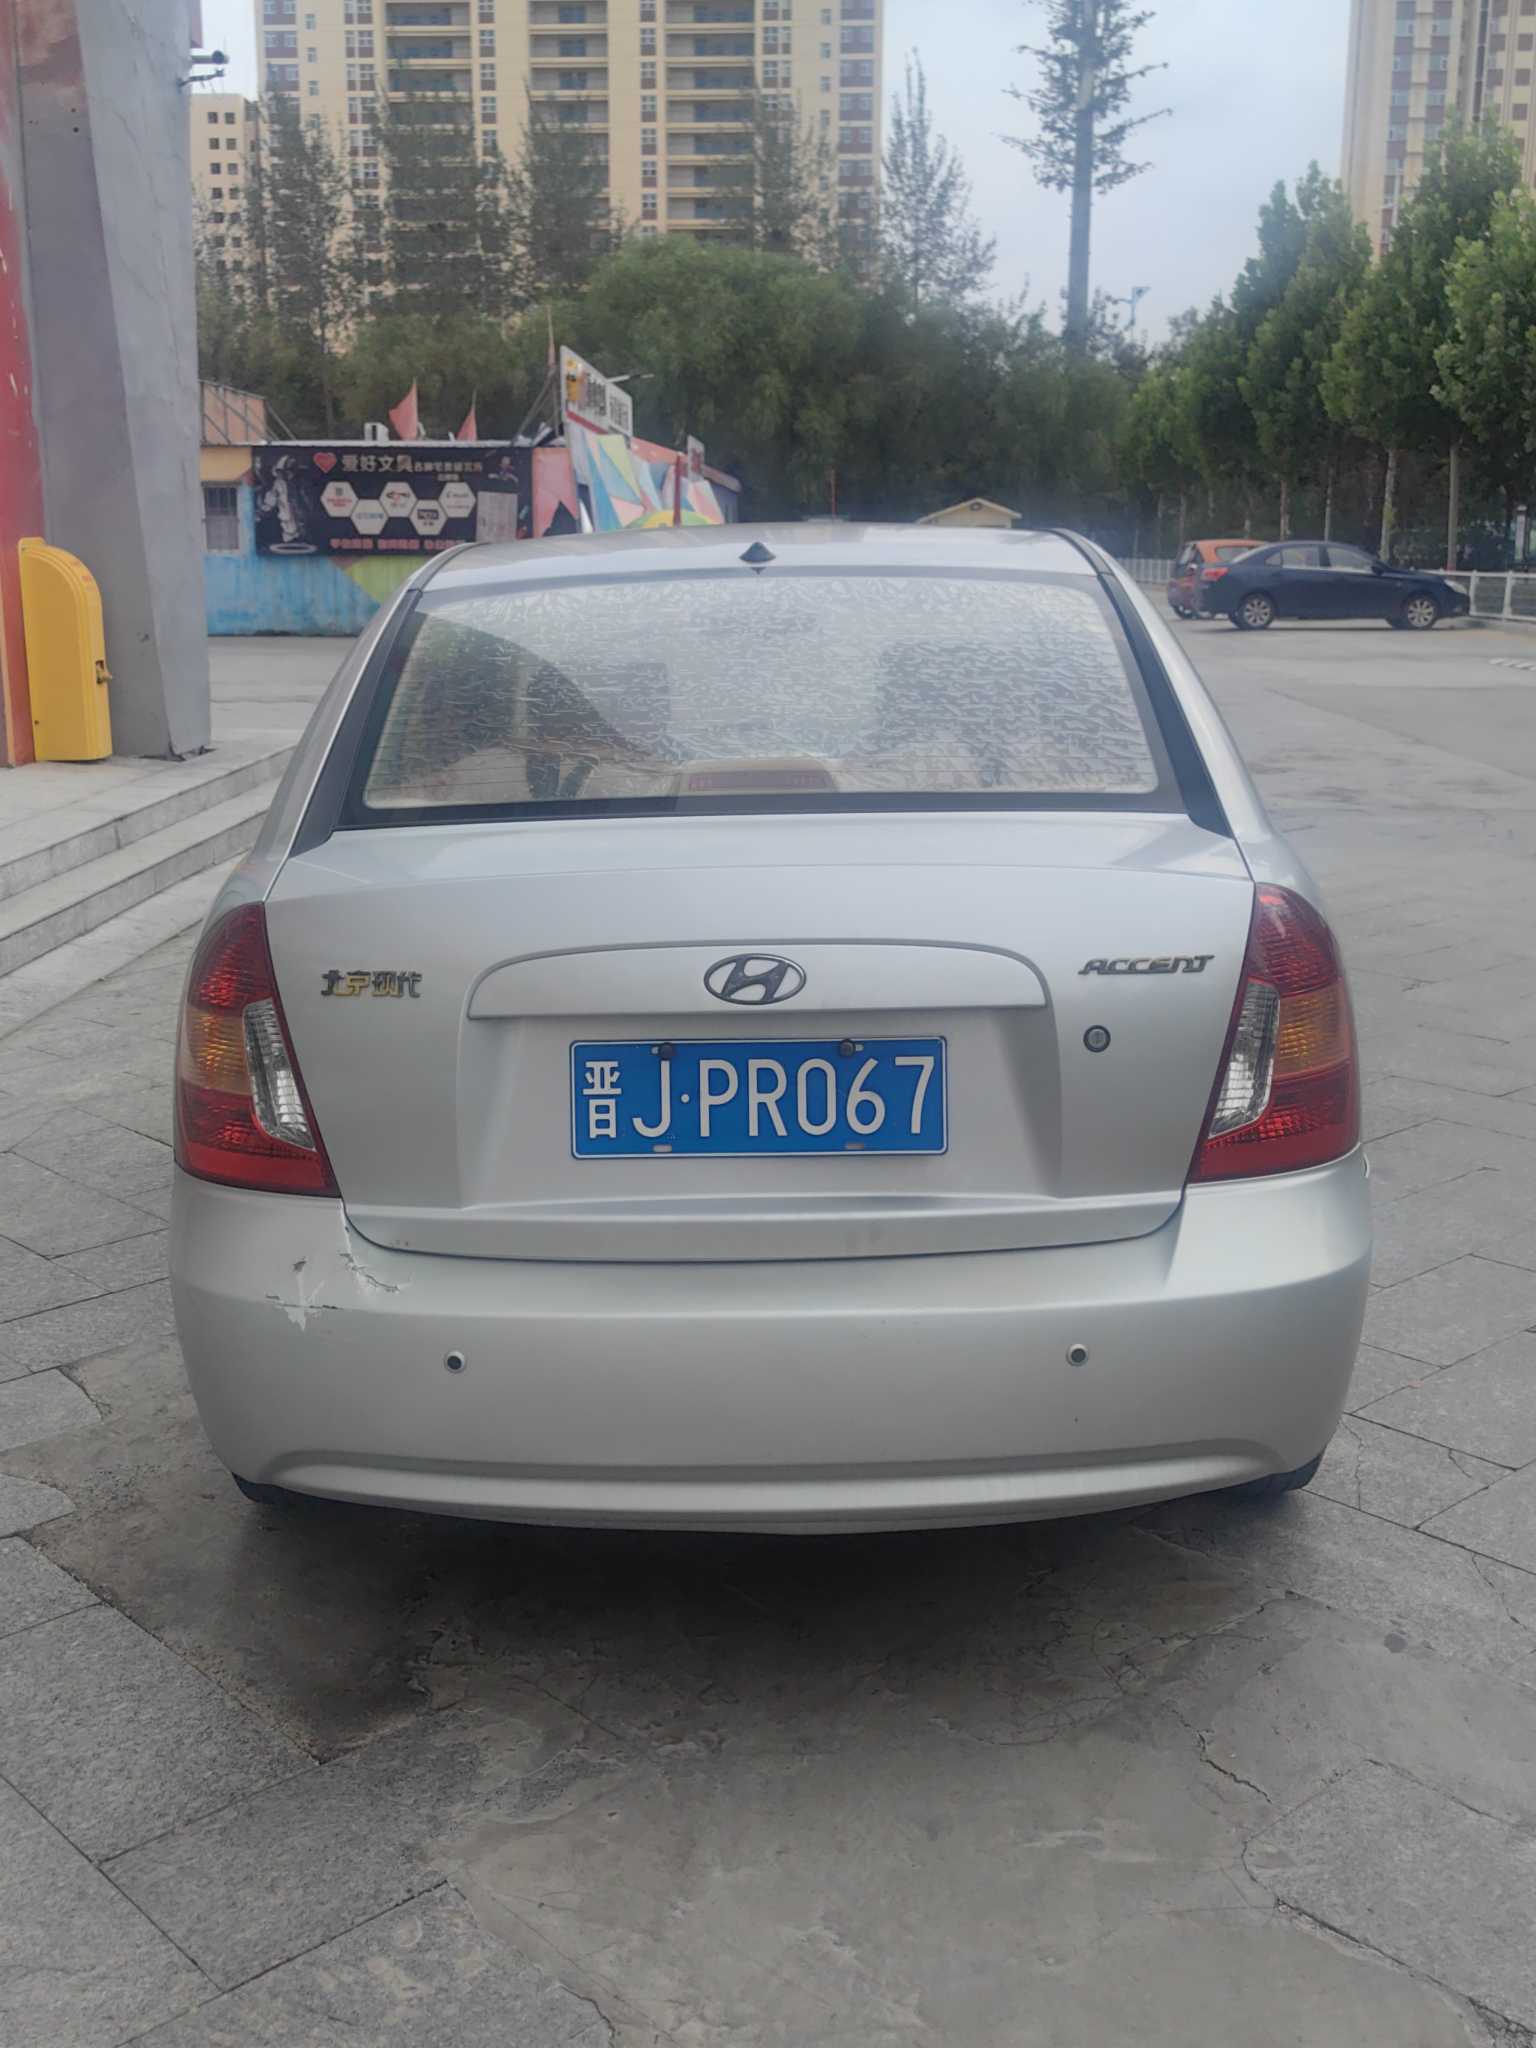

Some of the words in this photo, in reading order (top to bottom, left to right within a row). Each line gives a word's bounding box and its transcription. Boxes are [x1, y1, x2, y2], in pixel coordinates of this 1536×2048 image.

[1078, 954, 1216, 976] ACCENT
[320, 970, 423, 998] 北京现代
[582, 1056, 935, 1140] 晋J·PR067
